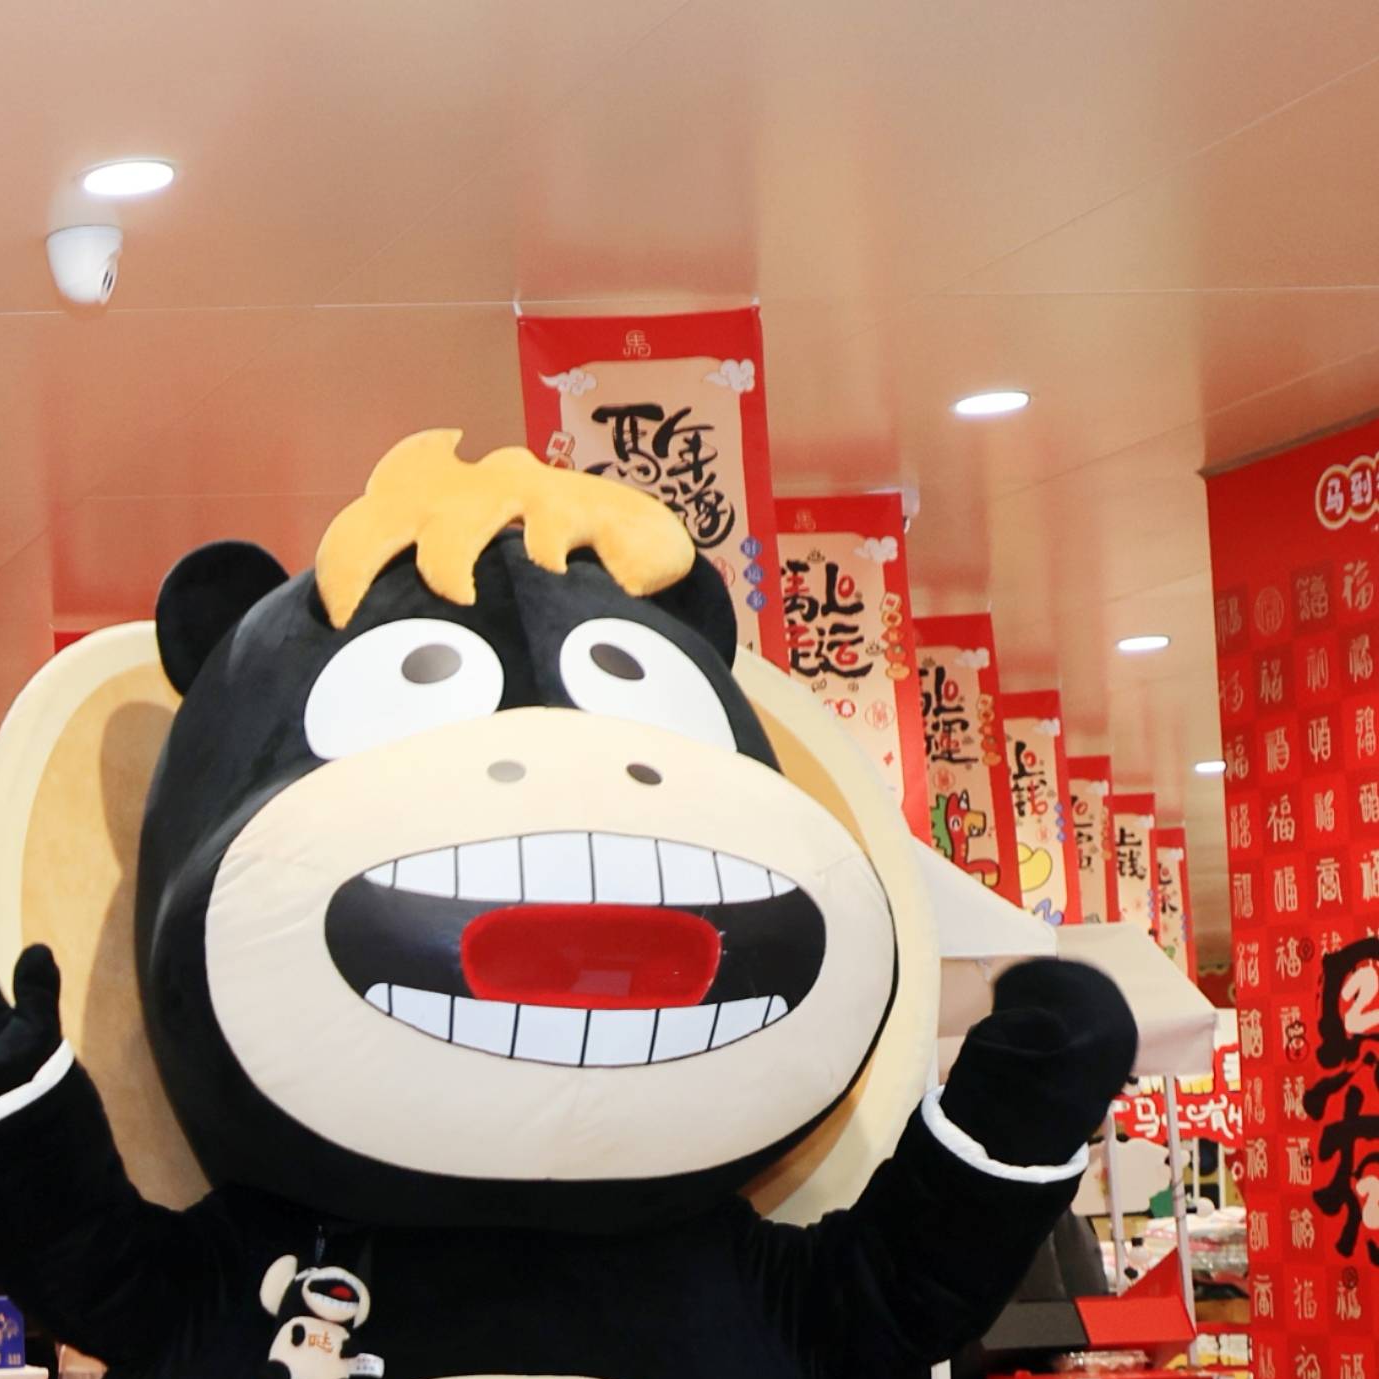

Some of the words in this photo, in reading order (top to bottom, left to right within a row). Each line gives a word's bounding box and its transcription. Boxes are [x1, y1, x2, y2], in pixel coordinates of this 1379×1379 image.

[1325, 467, 1379, 514] 马到
[1343, 560, 1374, 611] 福
[1267, 794, 1296, 844] 福
